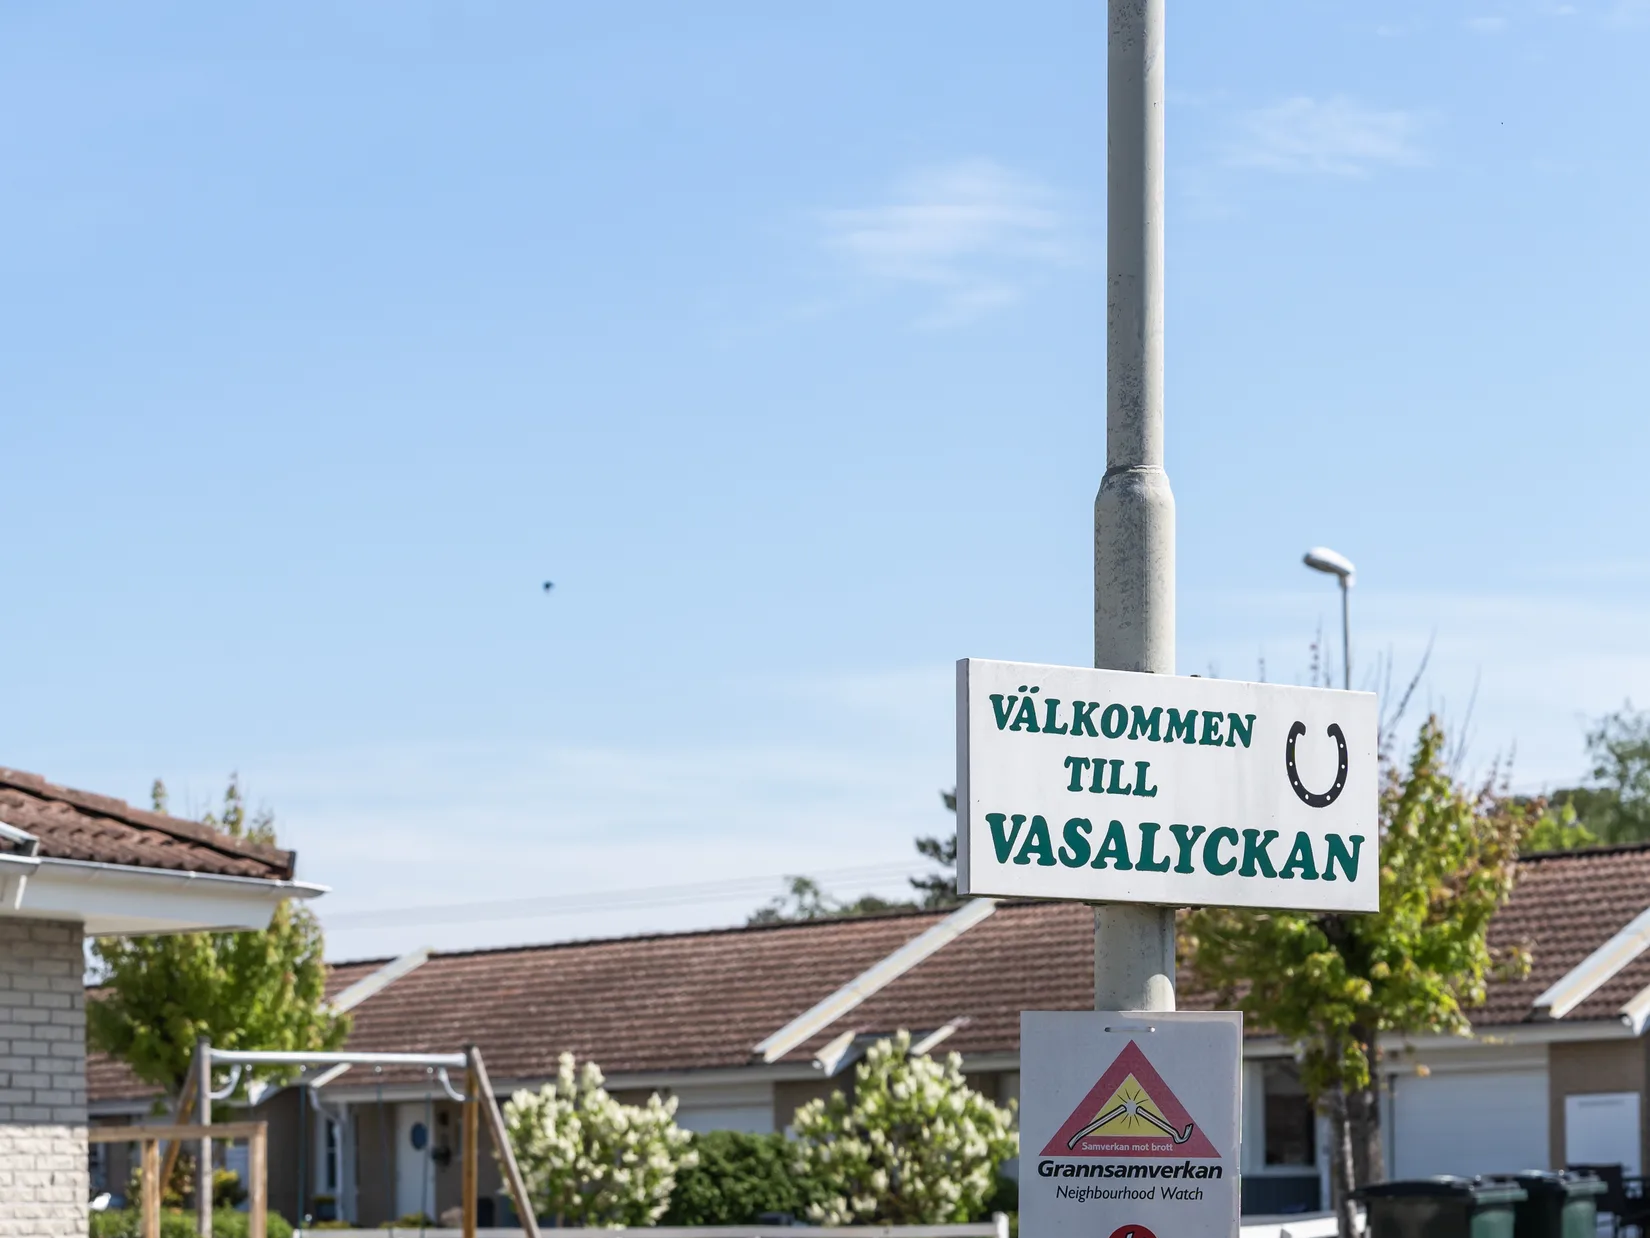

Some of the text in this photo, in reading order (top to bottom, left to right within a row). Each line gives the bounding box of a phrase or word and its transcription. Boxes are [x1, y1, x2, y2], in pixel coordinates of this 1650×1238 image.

[988, 684, 1257, 748] VÄLKOMMEN
[1063, 755, 1158, 798] TILL
[985, 812, 1365, 883] VASALYCKAN
[1081, 1141, 1174, 1152] Samverkan mot brott
[1037, 1160, 1223, 1179] Grannsamverkan
[1056, 1185, 1204, 1203] Neighbourhood Watch
